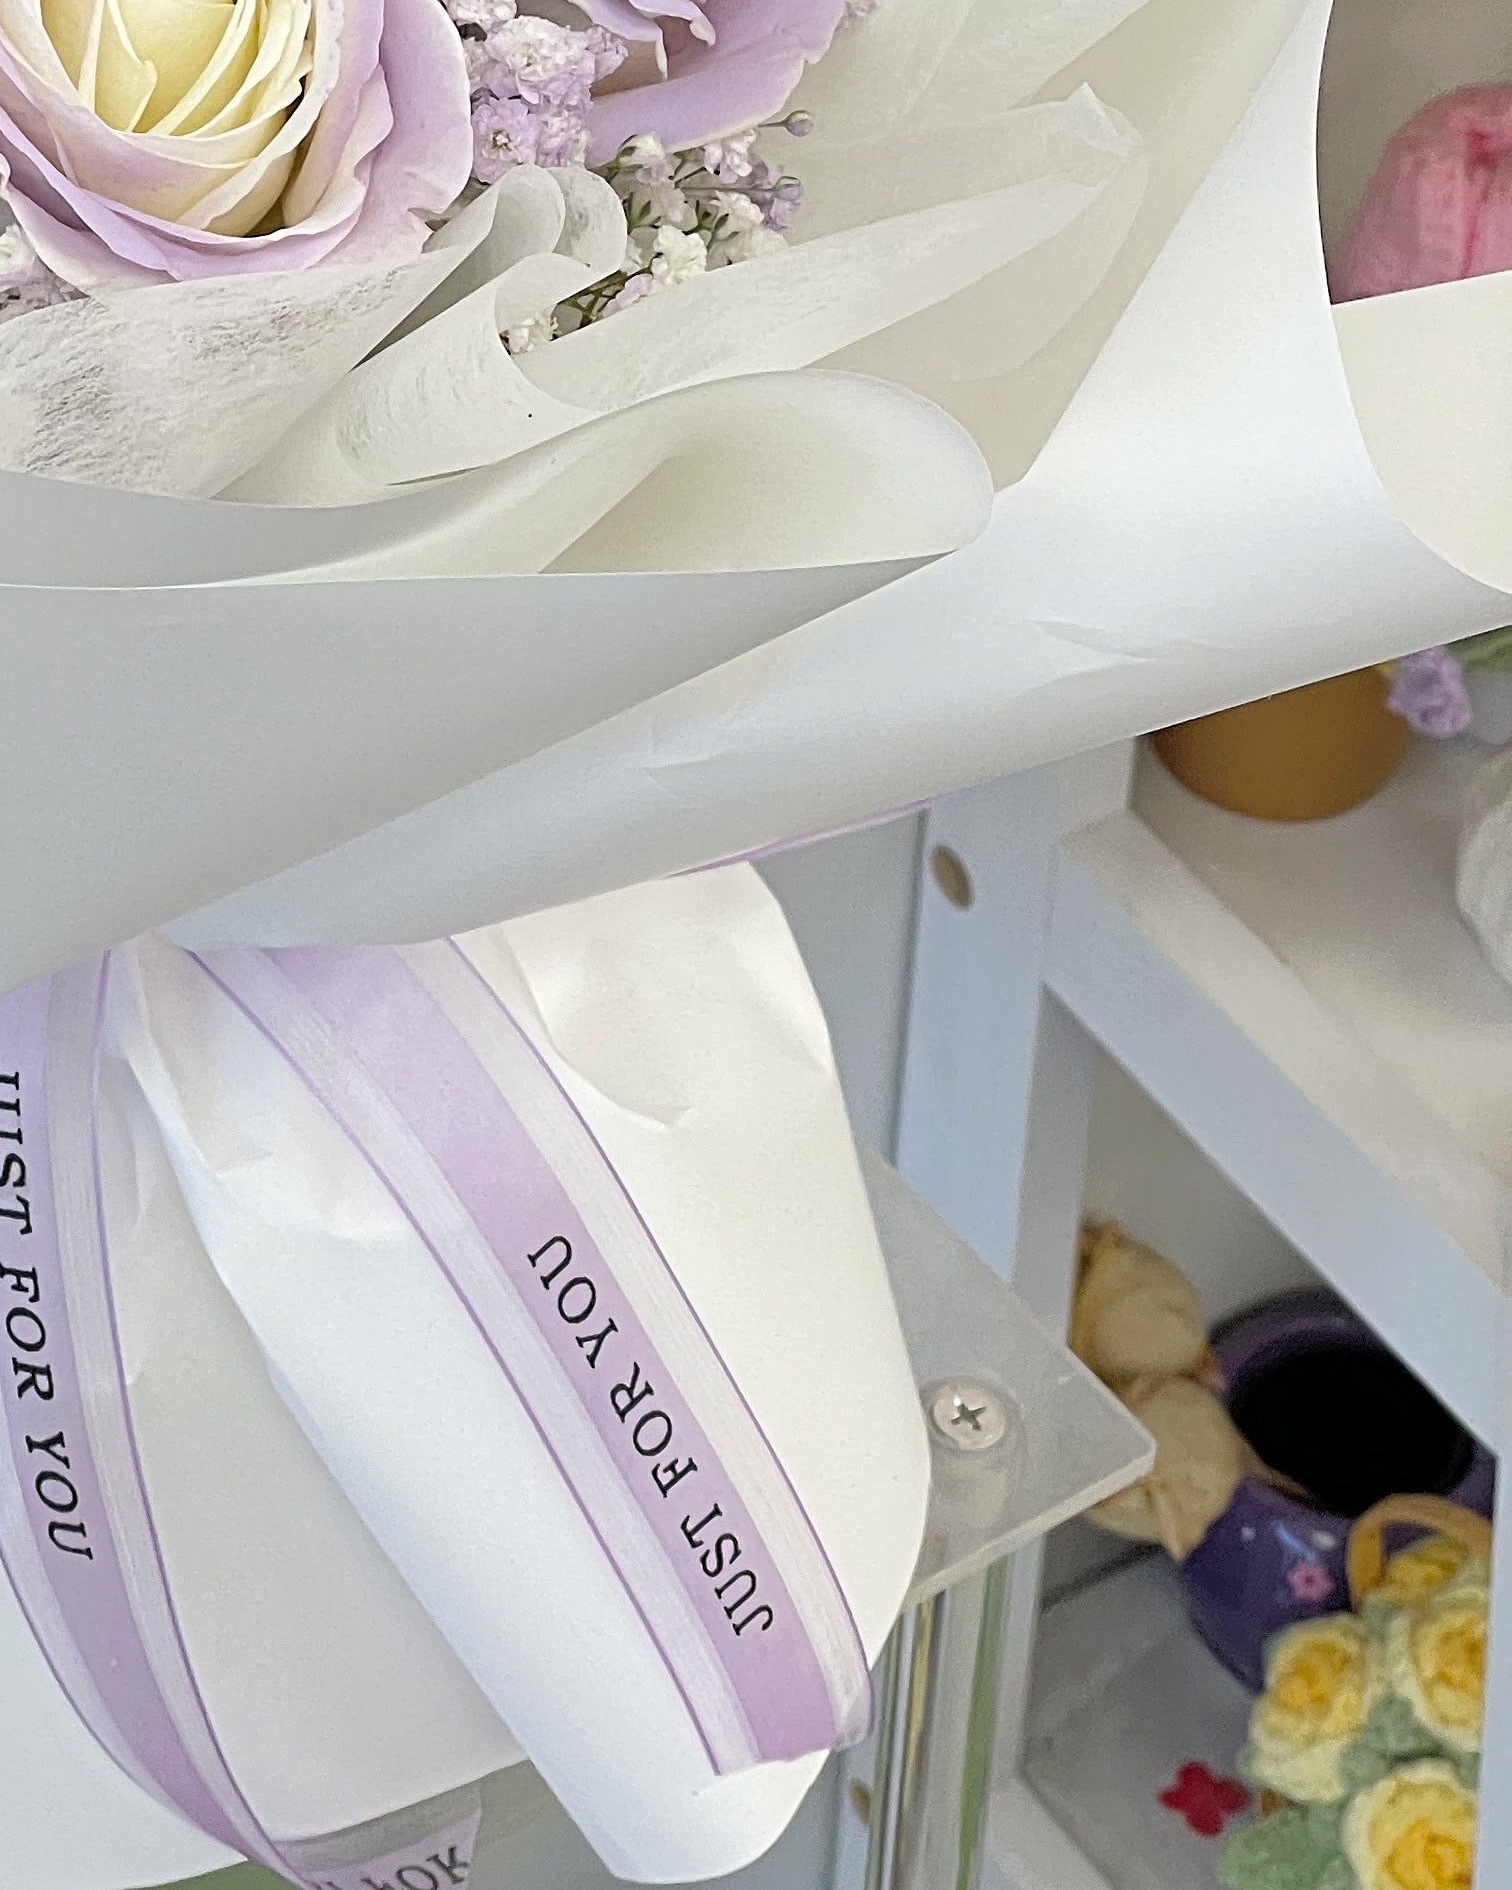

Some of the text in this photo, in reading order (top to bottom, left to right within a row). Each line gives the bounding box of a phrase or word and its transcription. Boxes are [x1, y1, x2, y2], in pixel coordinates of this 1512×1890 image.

[25, 1431, 94, 1560] YOU
[527, 1235, 774, 1636] JUST FOR YOU
